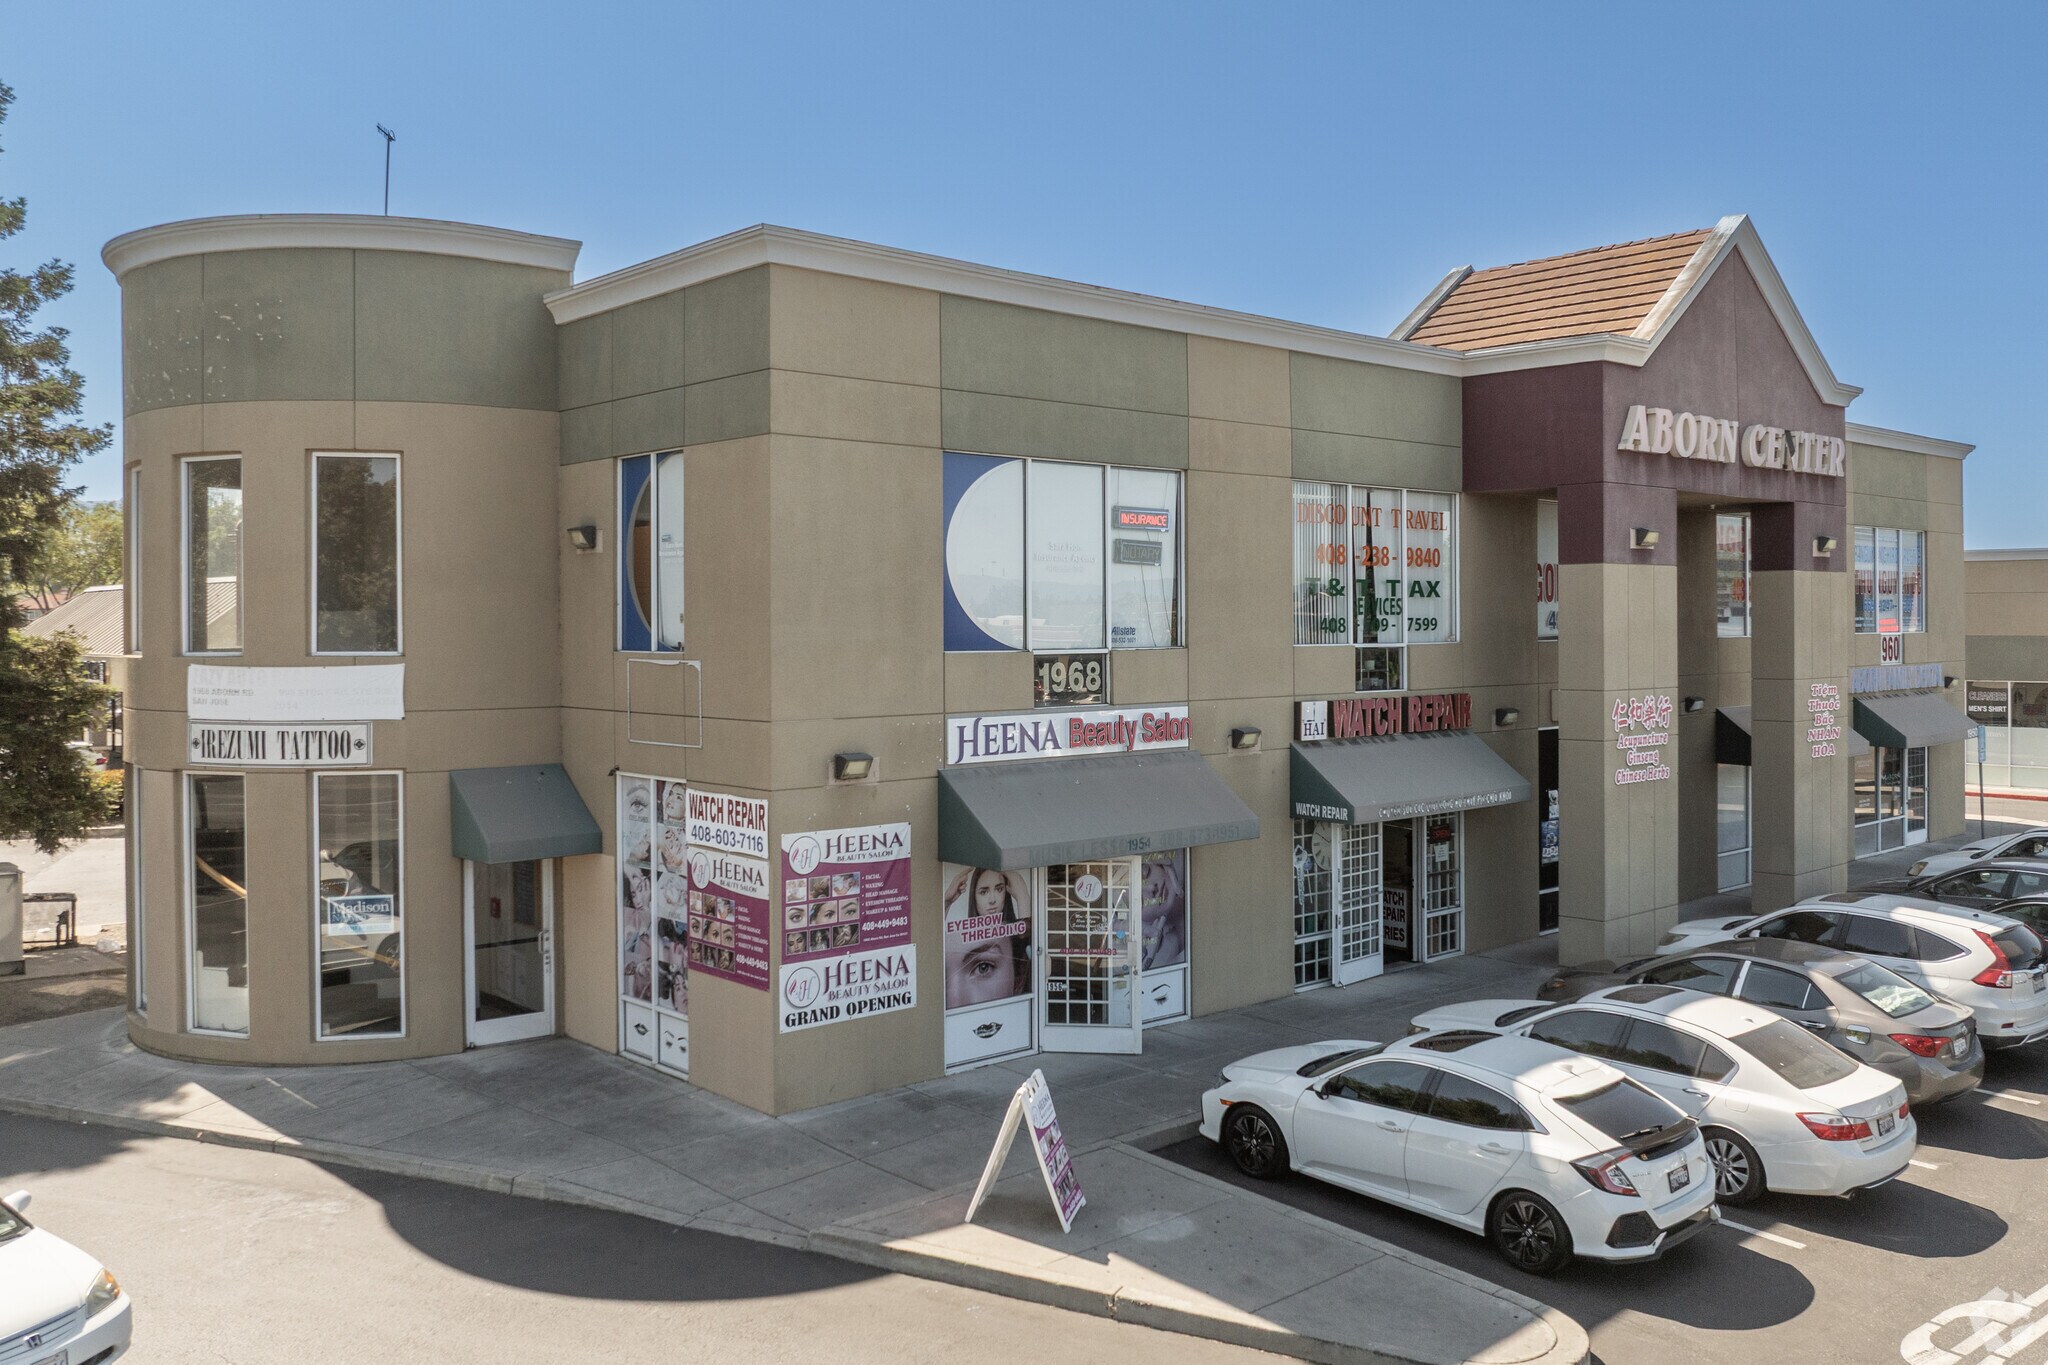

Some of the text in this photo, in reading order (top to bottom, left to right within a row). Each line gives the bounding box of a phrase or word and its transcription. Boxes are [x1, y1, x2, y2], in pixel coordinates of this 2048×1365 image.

[1617, 404, 1846, 477] ABORN CENTER
[1120, 512, 1168, 527] INSURANCE
[1391, 507, 1448, 531] TRAVEL
[1122, 546, 1160, 560] NOTARY
[1385, 579, 1441, 598] TAX
[1111, 626, 1136, 636] Allstate
[1037, 660, 1101, 693] 1968
[1333, 693, 1473, 738] WATCH REPAIR
[1968, 705, 2008, 713] MEN'S SHIRT
[955, 711, 1194, 764] HEENA Beauty Salon
[1303, 722, 1325, 737] HAI
[200, 729, 352, 760] IREZUMI TATTOO
[1617, 732, 1669, 749] Acupuncture
[1627, 750, 1660, 766] Ginseng
[1615, 764, 1670, 785] Chinese Herbs
[689, 793, 766, 831] WATCH REPAIR
[1295, 802, 1348, 821] WATCH REPAIR
[691, 825, 764, 853] 408-603-7116
[824, 832, 904, 860] HEENA
[837, 849, 893, 863] BEAUTY SALON
[712, 858, 764, 887] HEENA
[332, 900, 390, 914] Madison
[1383, 890, 1405, 906] ATCH
[946, 912, 1003, 933] EYEBROW
[1383, 908, 1406, 923] EPAIR
[961, 920, 1026, 943] THREADING
[823, 954, 910, 995] HEENA
[828, 977, 909, 1001] BEAUTY SALON
[785, 991, 912, 1028] GRAND OPENING
